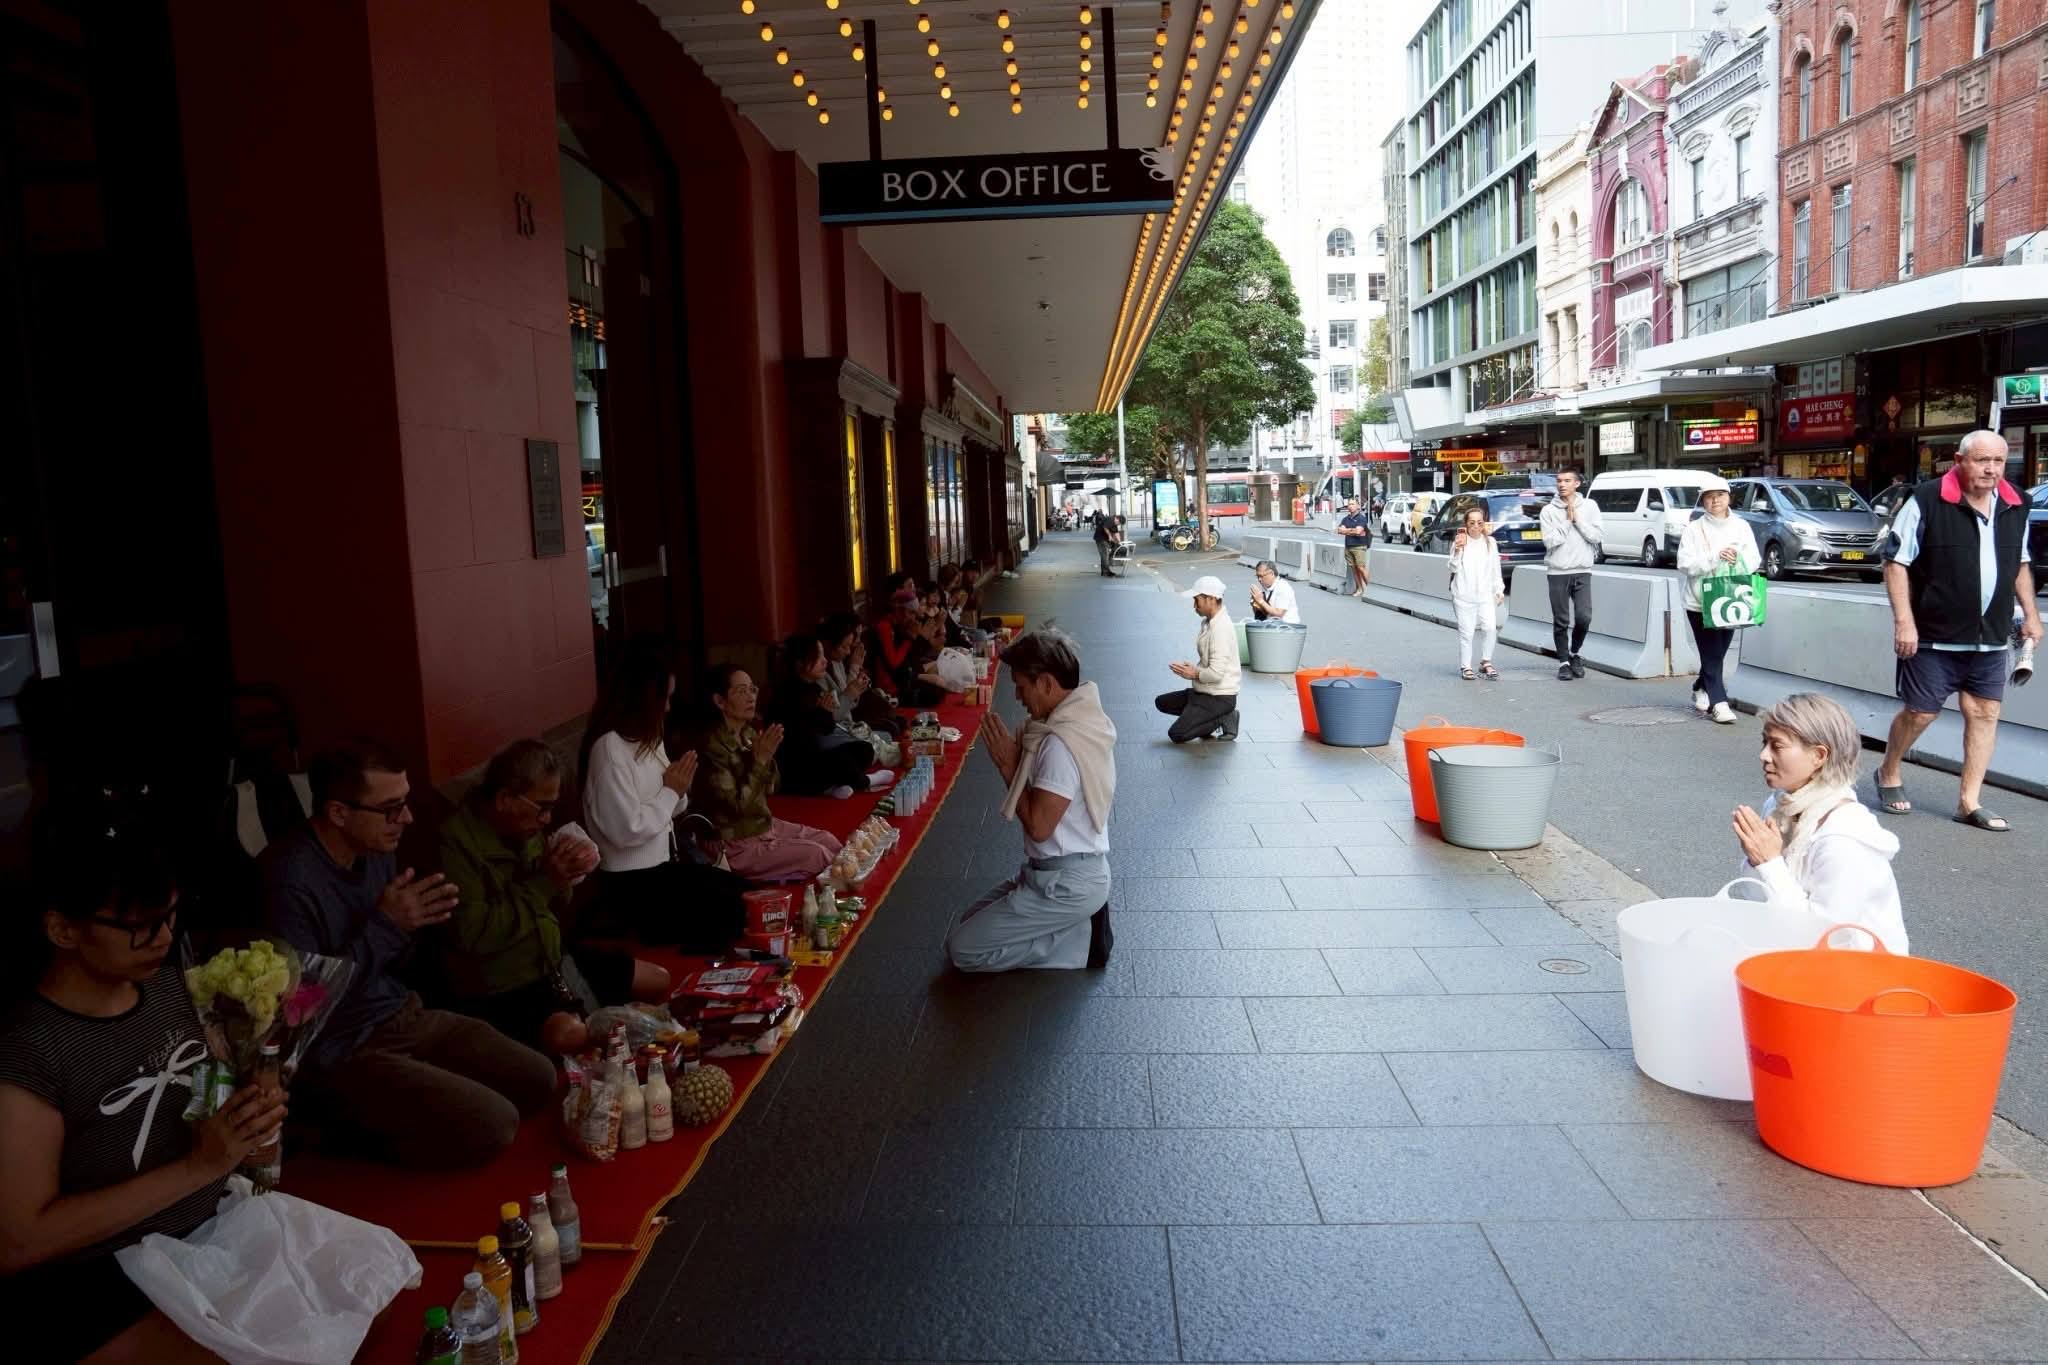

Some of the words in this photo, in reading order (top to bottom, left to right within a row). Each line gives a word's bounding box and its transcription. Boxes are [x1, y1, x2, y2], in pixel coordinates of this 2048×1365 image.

[882, 168, 967, 203] BOX
[980, 162, 1112, 198] OFFICE
[1804, 401, 1819, 413] MAE
[1819, 399, 1844, 411] CHENG
